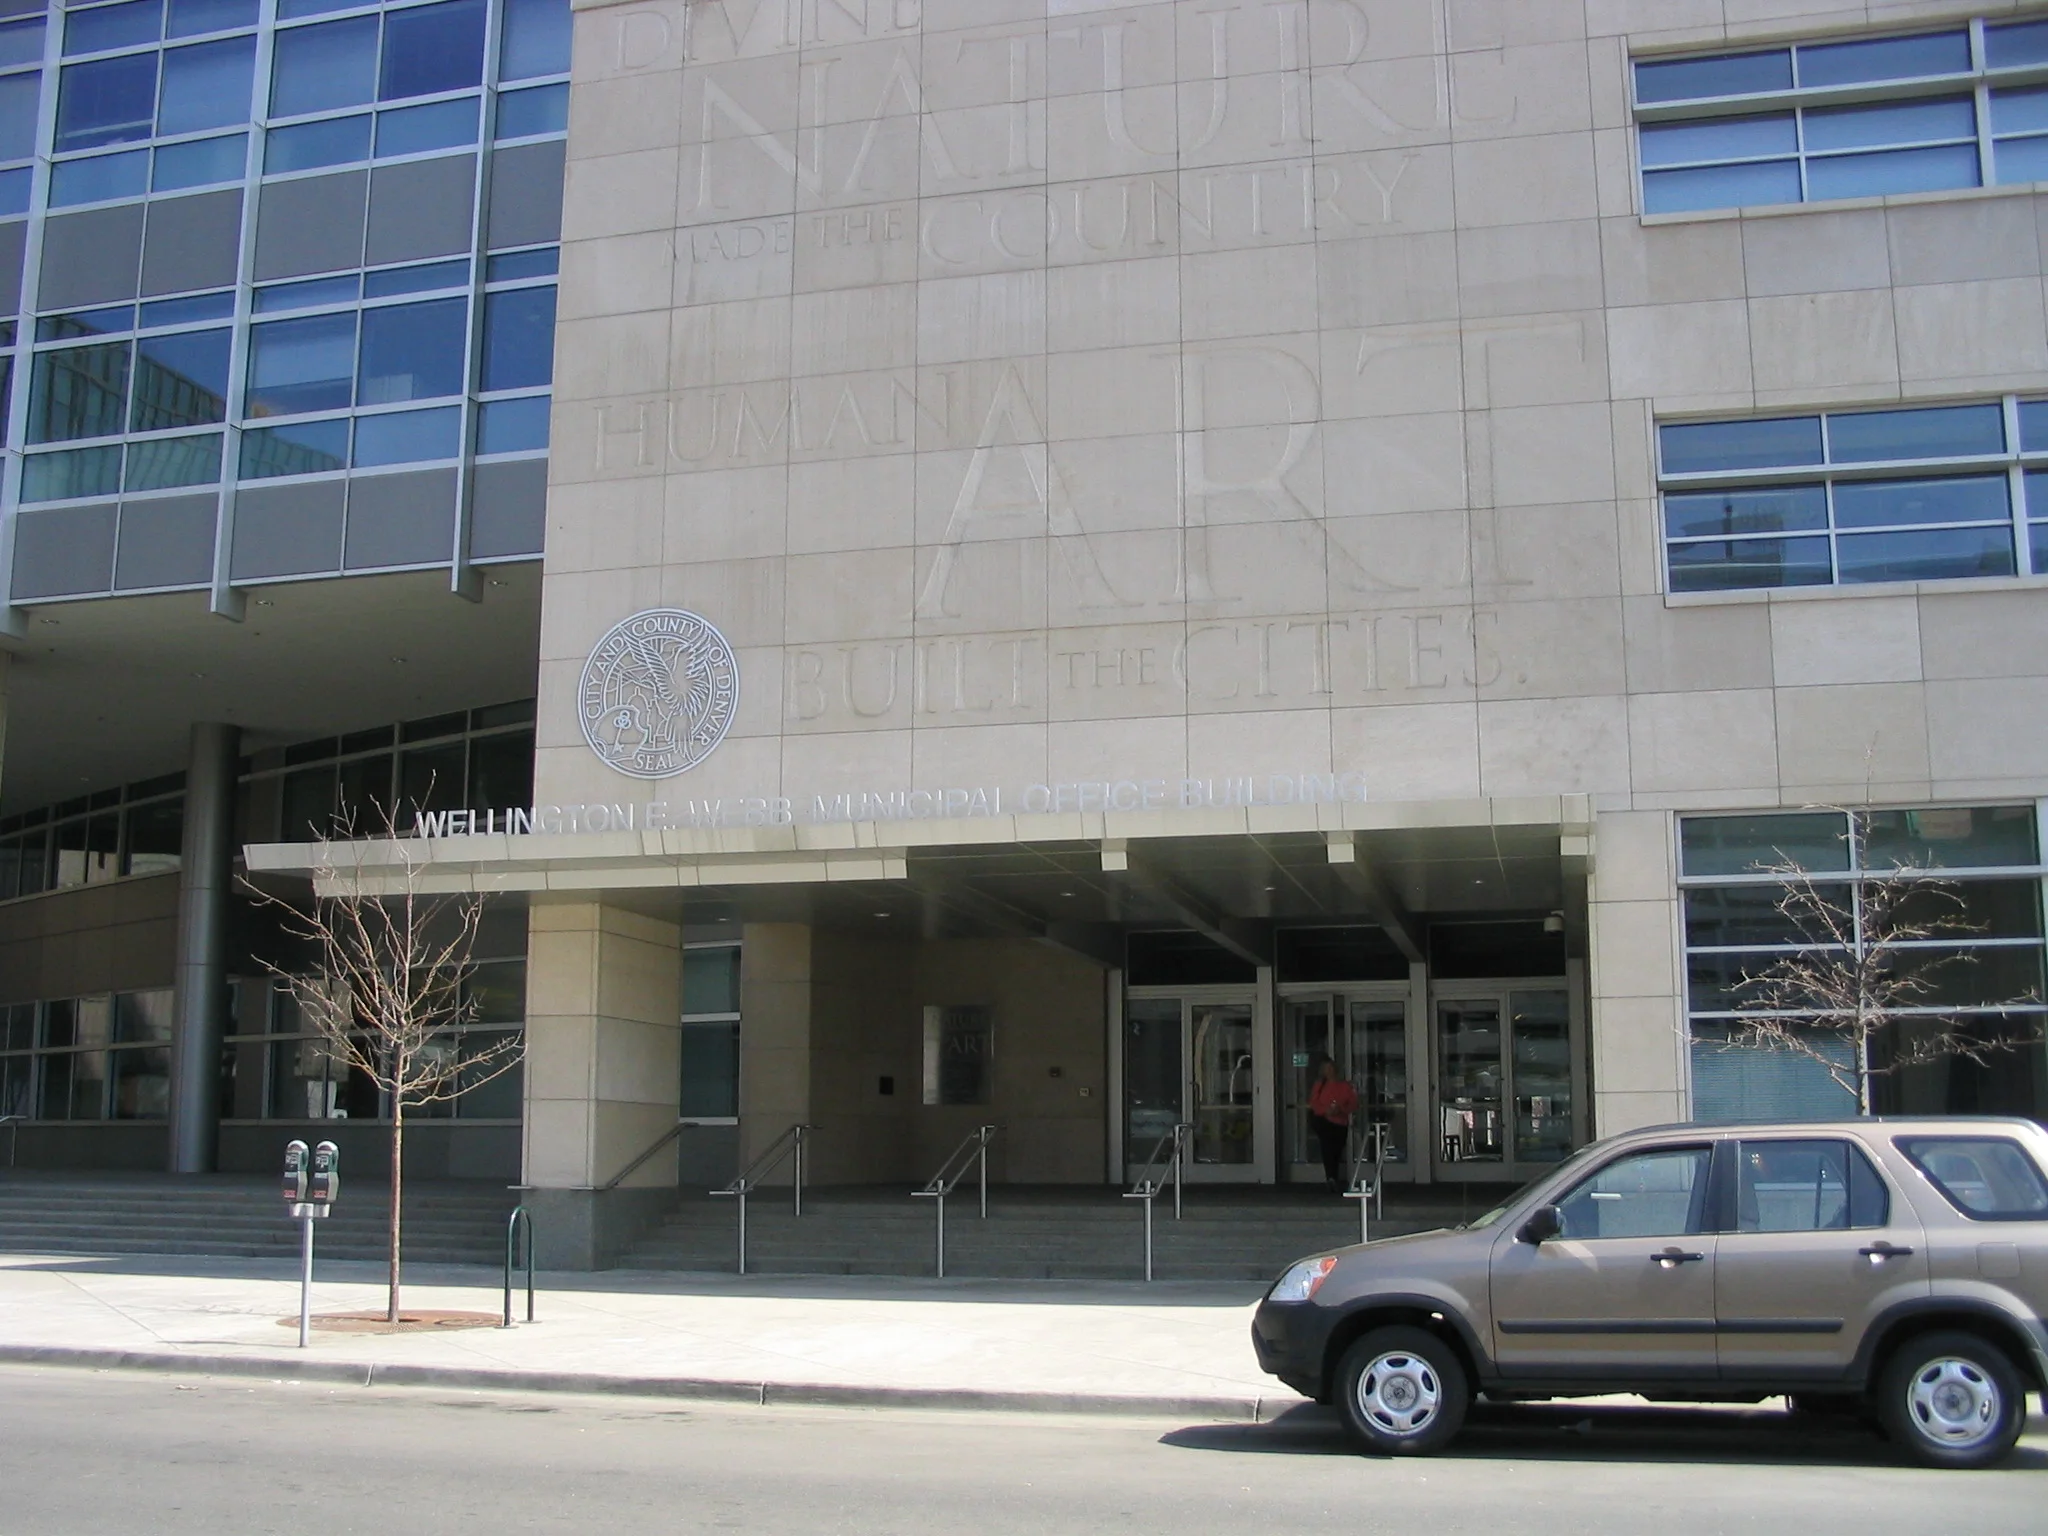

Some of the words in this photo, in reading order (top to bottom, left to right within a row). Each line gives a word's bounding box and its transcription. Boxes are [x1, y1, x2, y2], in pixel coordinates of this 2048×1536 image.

[688, 0, 1518, 212] NATURE
[662, 220, 791, 268] MADE
[812, 208, 904, 249] THE
[921, 153, 1422, 266] COUNTRY
[593, 366, 956, 473] HUMAN
[898, 318, 1586, 623] ART
[594, 636, 626, 674] AND
[631, 616, 700, 638] COUNTY
[708, 646, 729, 669] OF
[585, 674, 603, 720] CITY
[696, 674, 731, 746] DENVER
[785, 636, 1041, 722] BUILT
[1056, 647, 1158, 690] THE
[634, 753, 678, 770] SEAL
[415, 802, 635, 839] WELLINGTON
[813, 786, 1001, 825] MUNICIPAL
[1022, 779, 1166, 813] OFFICE
[1179, 770, 1368, 809] BUILDING
